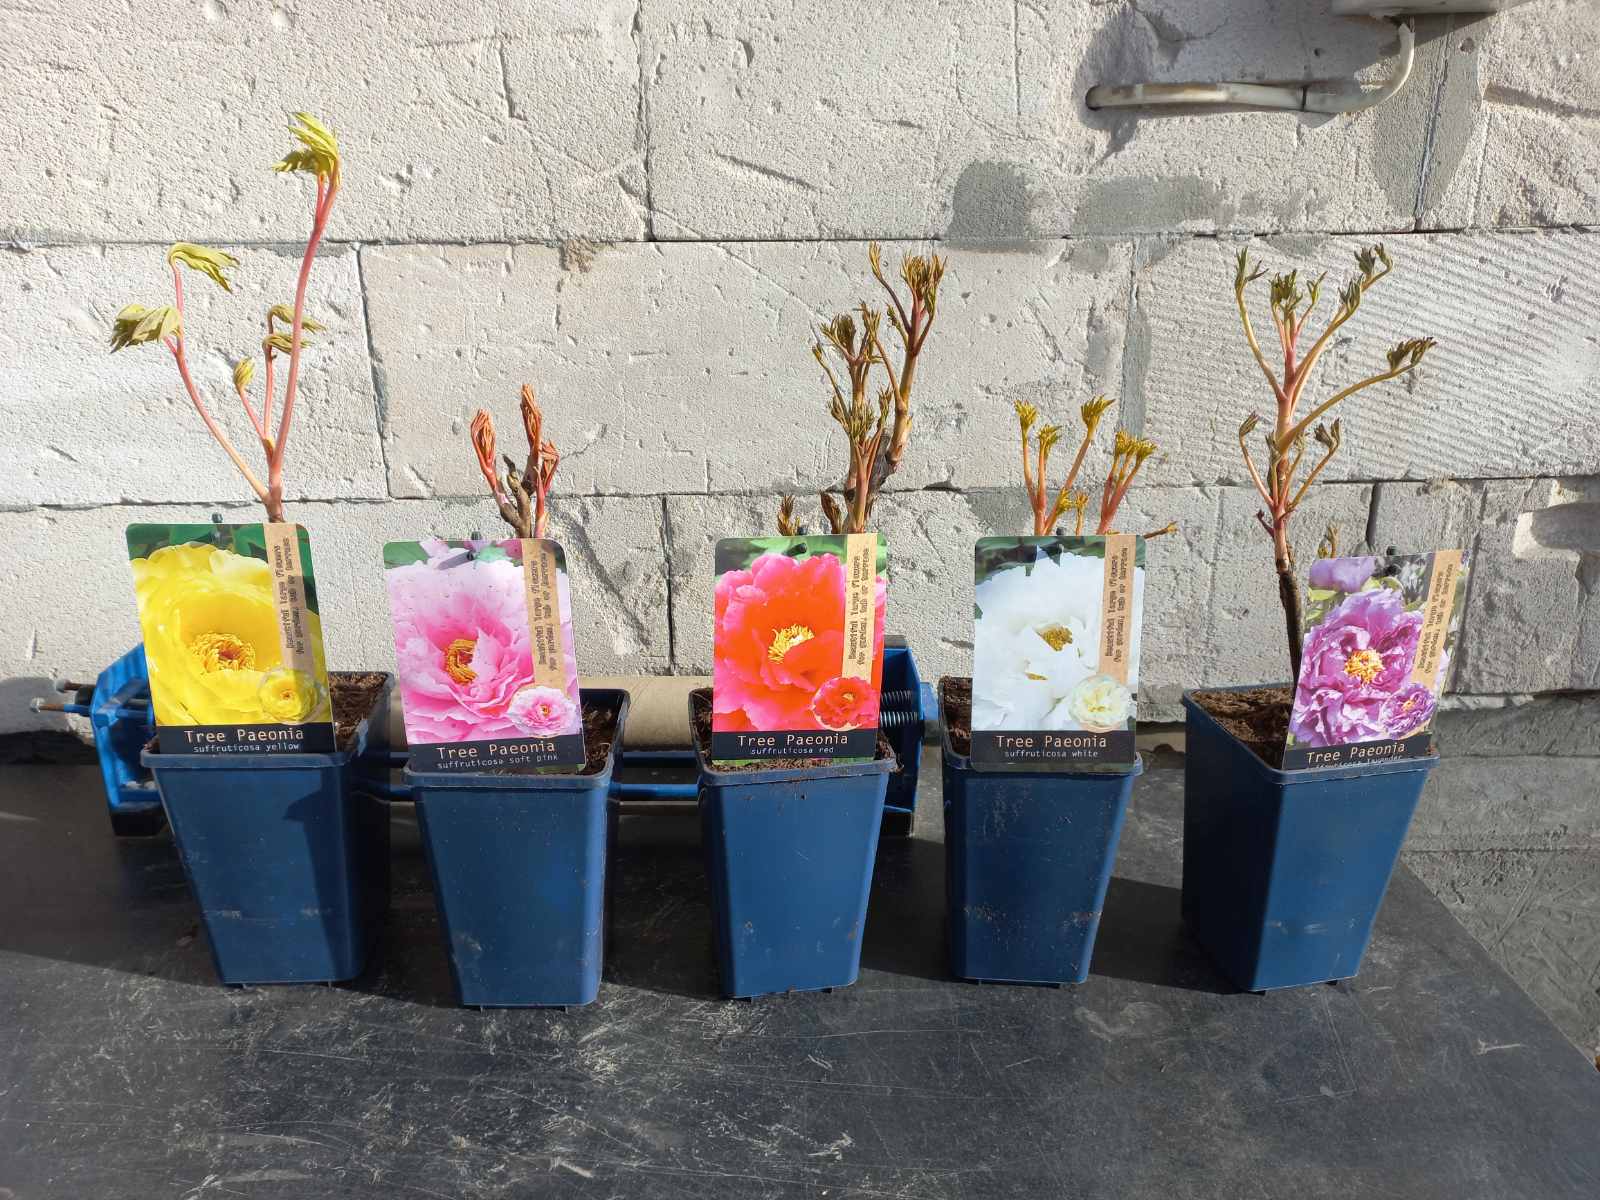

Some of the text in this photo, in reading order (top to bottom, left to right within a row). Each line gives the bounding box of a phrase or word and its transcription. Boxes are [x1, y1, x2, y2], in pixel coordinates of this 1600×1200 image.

[184, 728, 304, 744] Tree Paeonia
[738, 733, 848, 746] Tree Paeonia
[996, 735, 1107, 748] Tree Paeonia
[193, 743, 299, 753] suffruticosa yellow
[437, 741, 555, 760] Tree Paeonia
[1005, 750, 1099, 758] suffruticosa white
[1306, 742, 1405, 764] Tree Paeonia
[437, 754, 558, 769] suffruticosa soft pink
